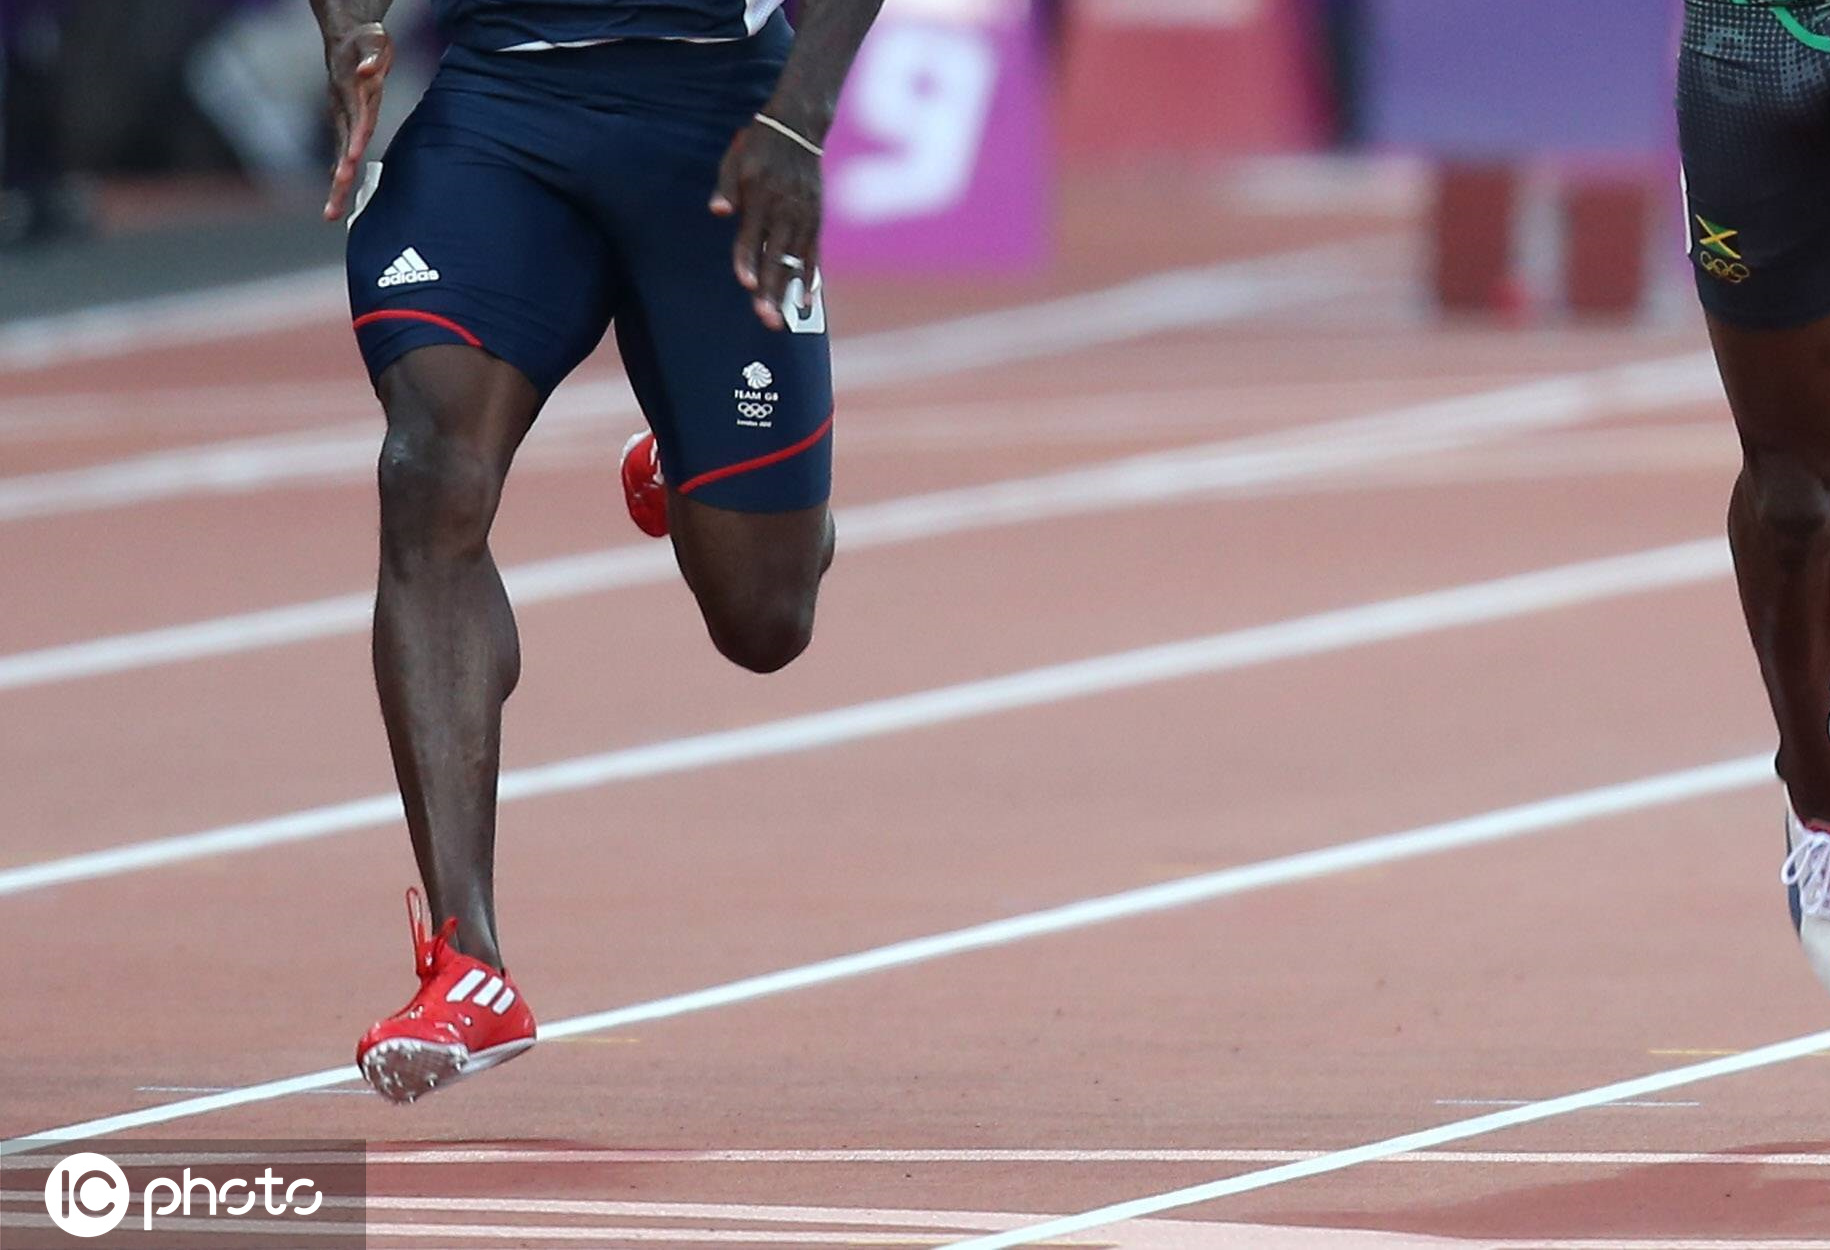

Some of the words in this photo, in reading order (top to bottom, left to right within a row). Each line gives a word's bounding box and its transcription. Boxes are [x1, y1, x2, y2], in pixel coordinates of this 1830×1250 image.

[832, 25, 997, 225] 9
[378, 269, 439, 288] adidas
[734, 389, 762, 401] TEAM
[764, 392, 779, 401] GB
